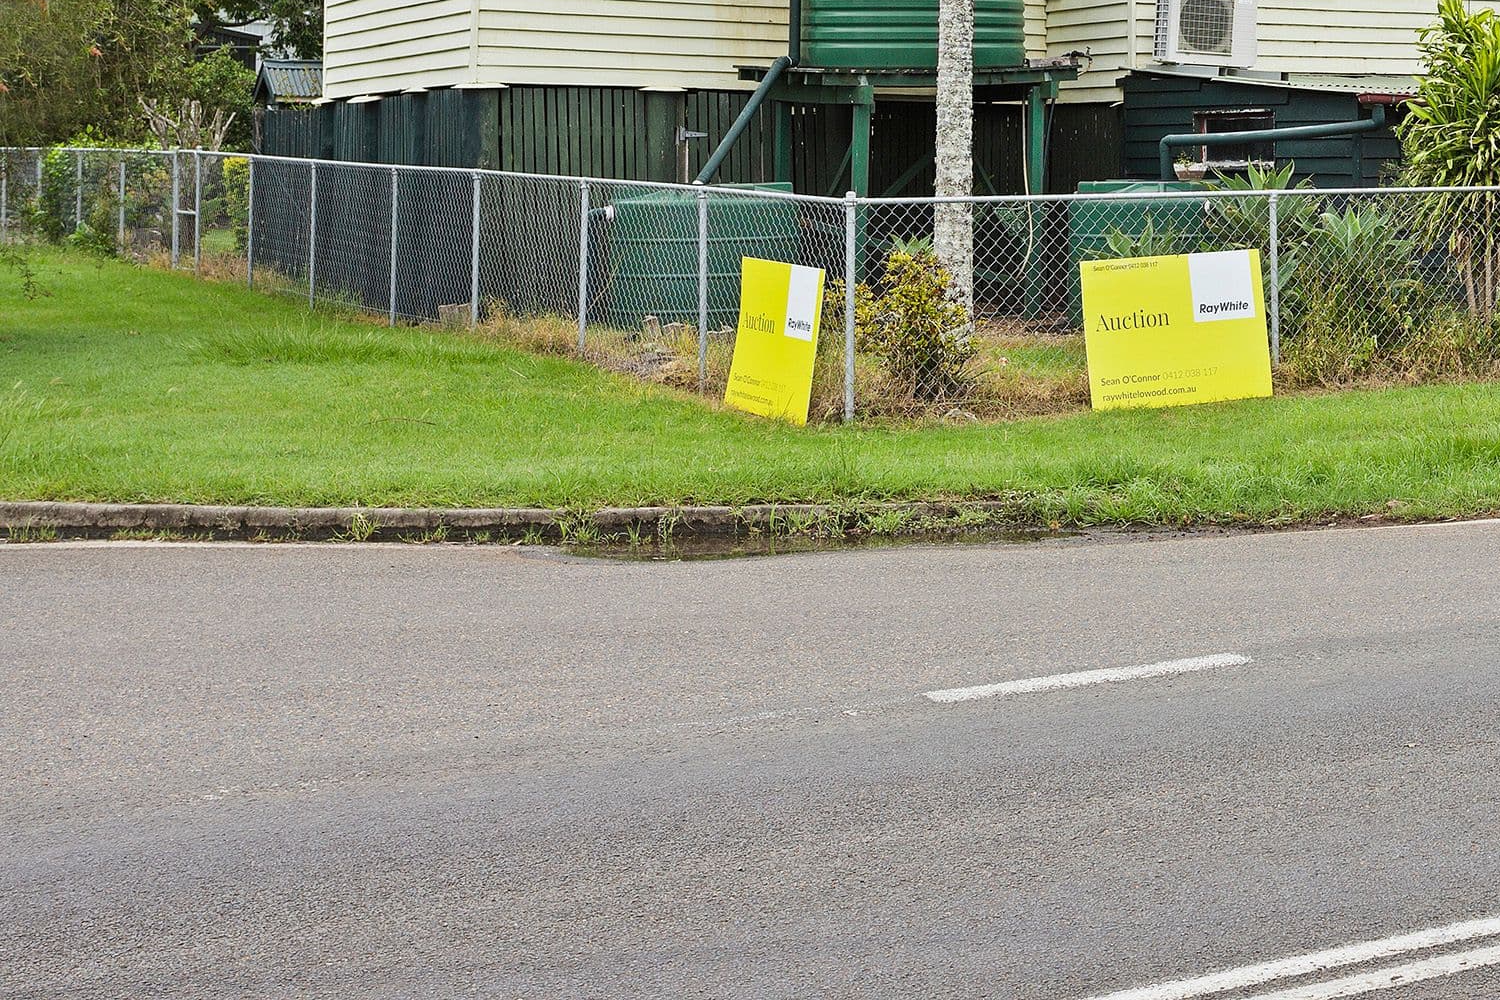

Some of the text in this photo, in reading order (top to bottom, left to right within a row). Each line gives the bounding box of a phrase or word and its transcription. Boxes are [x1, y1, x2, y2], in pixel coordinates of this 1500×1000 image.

[742, 311, 775, 334] Auction
[1096, 309, 1170, 332] Auction
[1101, 366, 1218, 387] Sean O'Connor 0412 038 117
[1102, 386, 1197, 402] raywhitelowood.com.au
